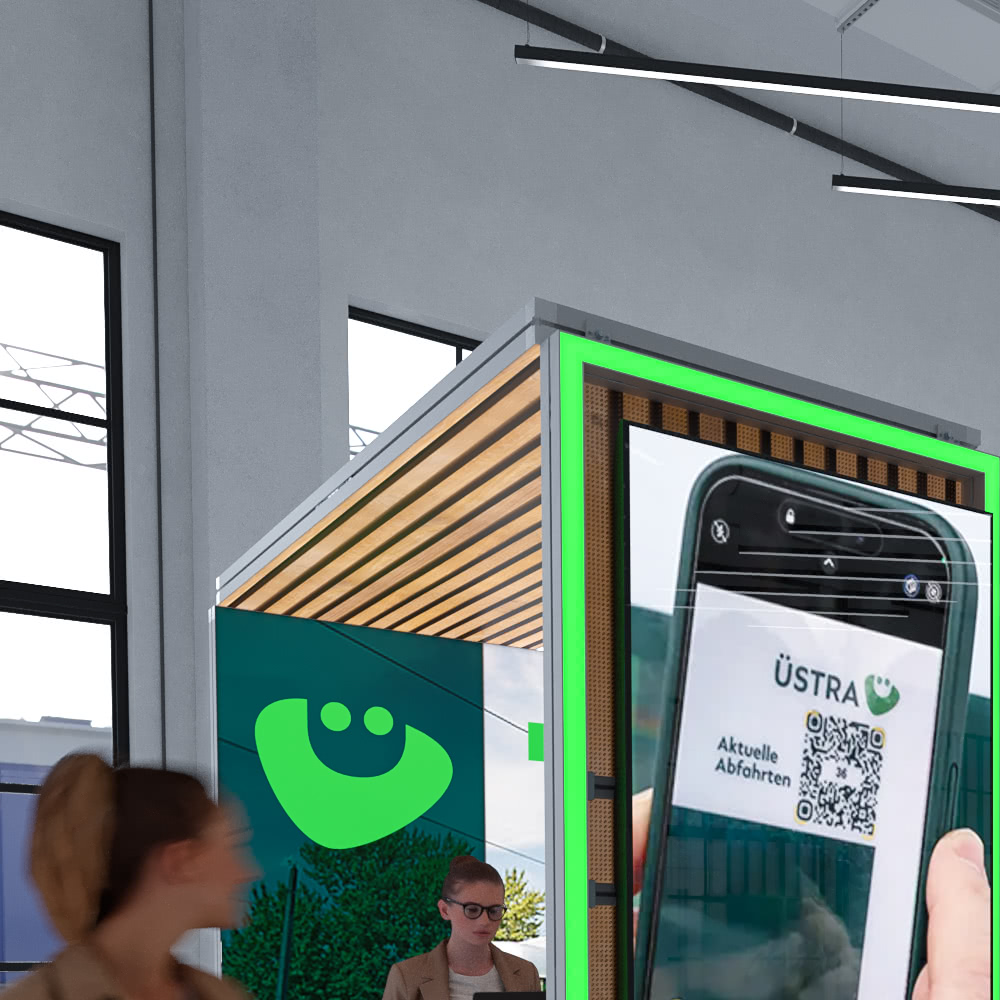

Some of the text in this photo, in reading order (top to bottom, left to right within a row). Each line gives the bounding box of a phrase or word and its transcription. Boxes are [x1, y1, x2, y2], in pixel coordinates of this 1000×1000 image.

[774, 653, 859, 707] ÜSTRA
[717, 736, 779, 764] Aktuelle
[715, 758, 791, 788] Abfahrten
